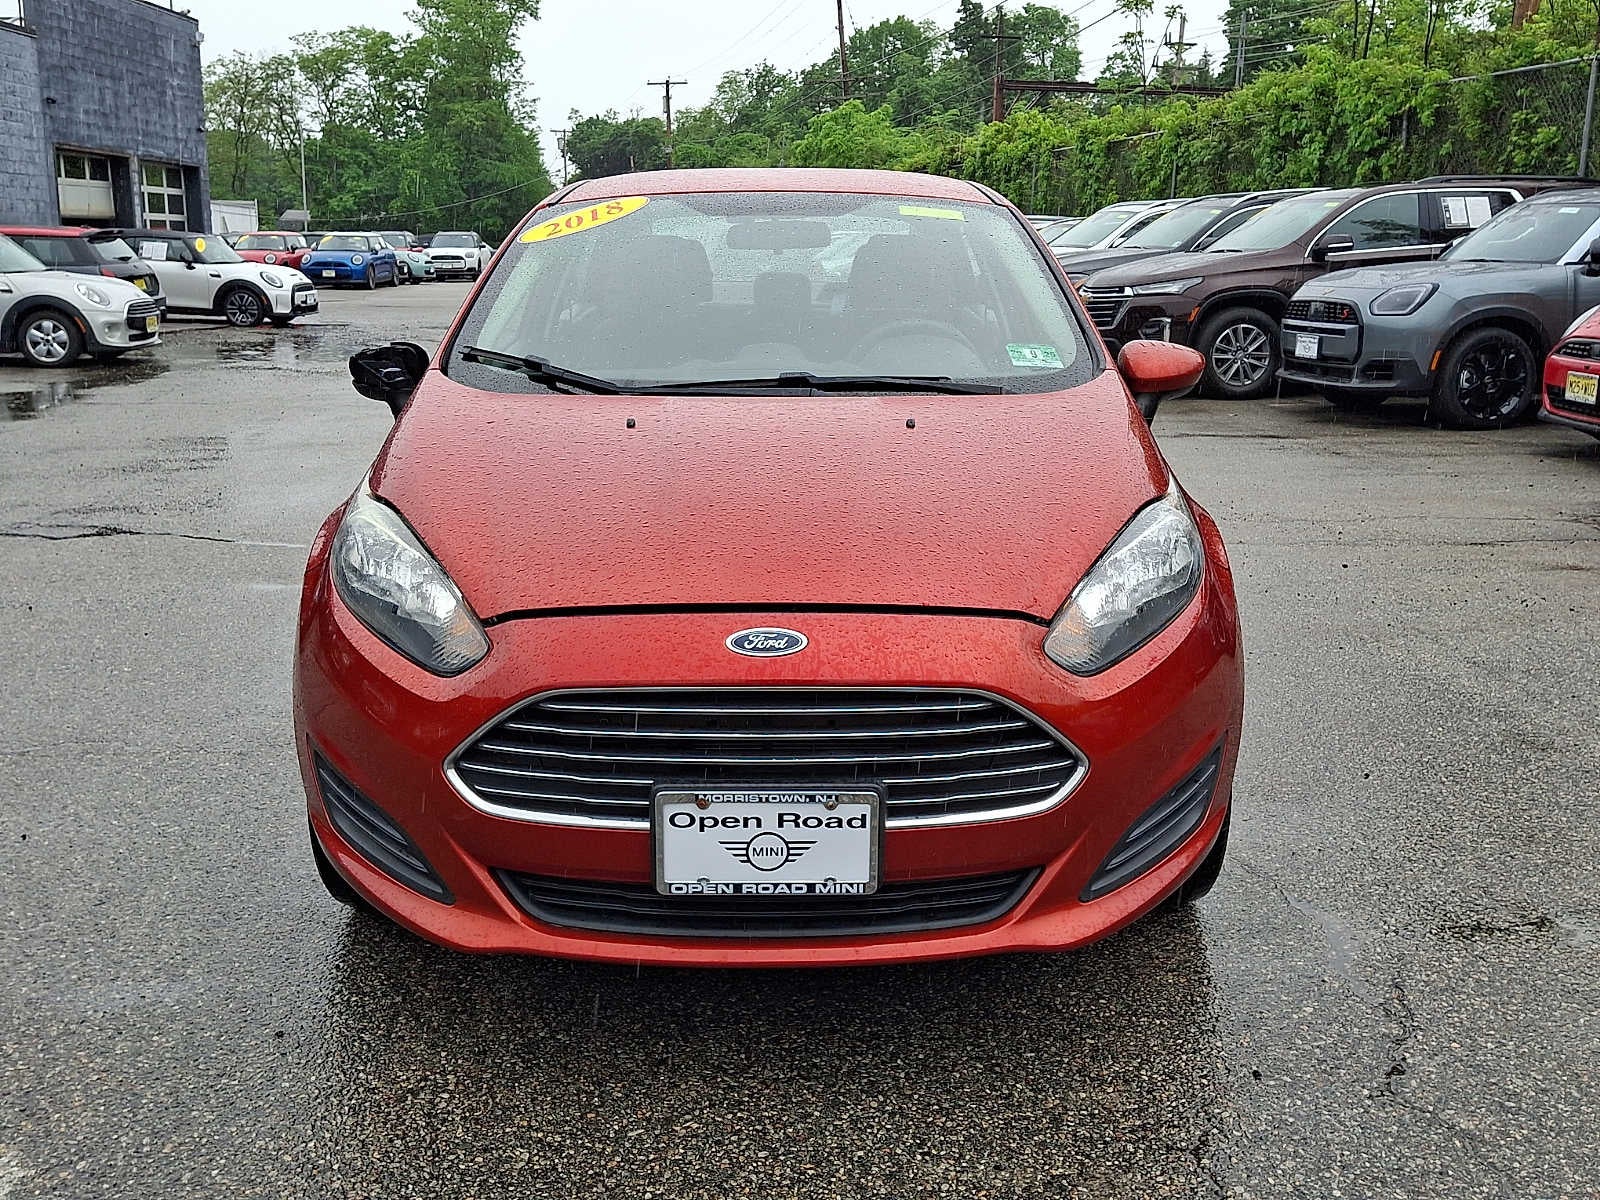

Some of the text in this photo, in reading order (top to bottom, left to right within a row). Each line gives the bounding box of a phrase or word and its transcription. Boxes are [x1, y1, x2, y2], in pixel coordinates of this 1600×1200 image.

[543, 201, 623, 237] 2018
[744, 633, 789, 649] Ford
[668, 811, 867, 833] Open Road
[752, 846, 784, 857] MINI
[670, 883, 864, 894] OPEN ROAD MINI
